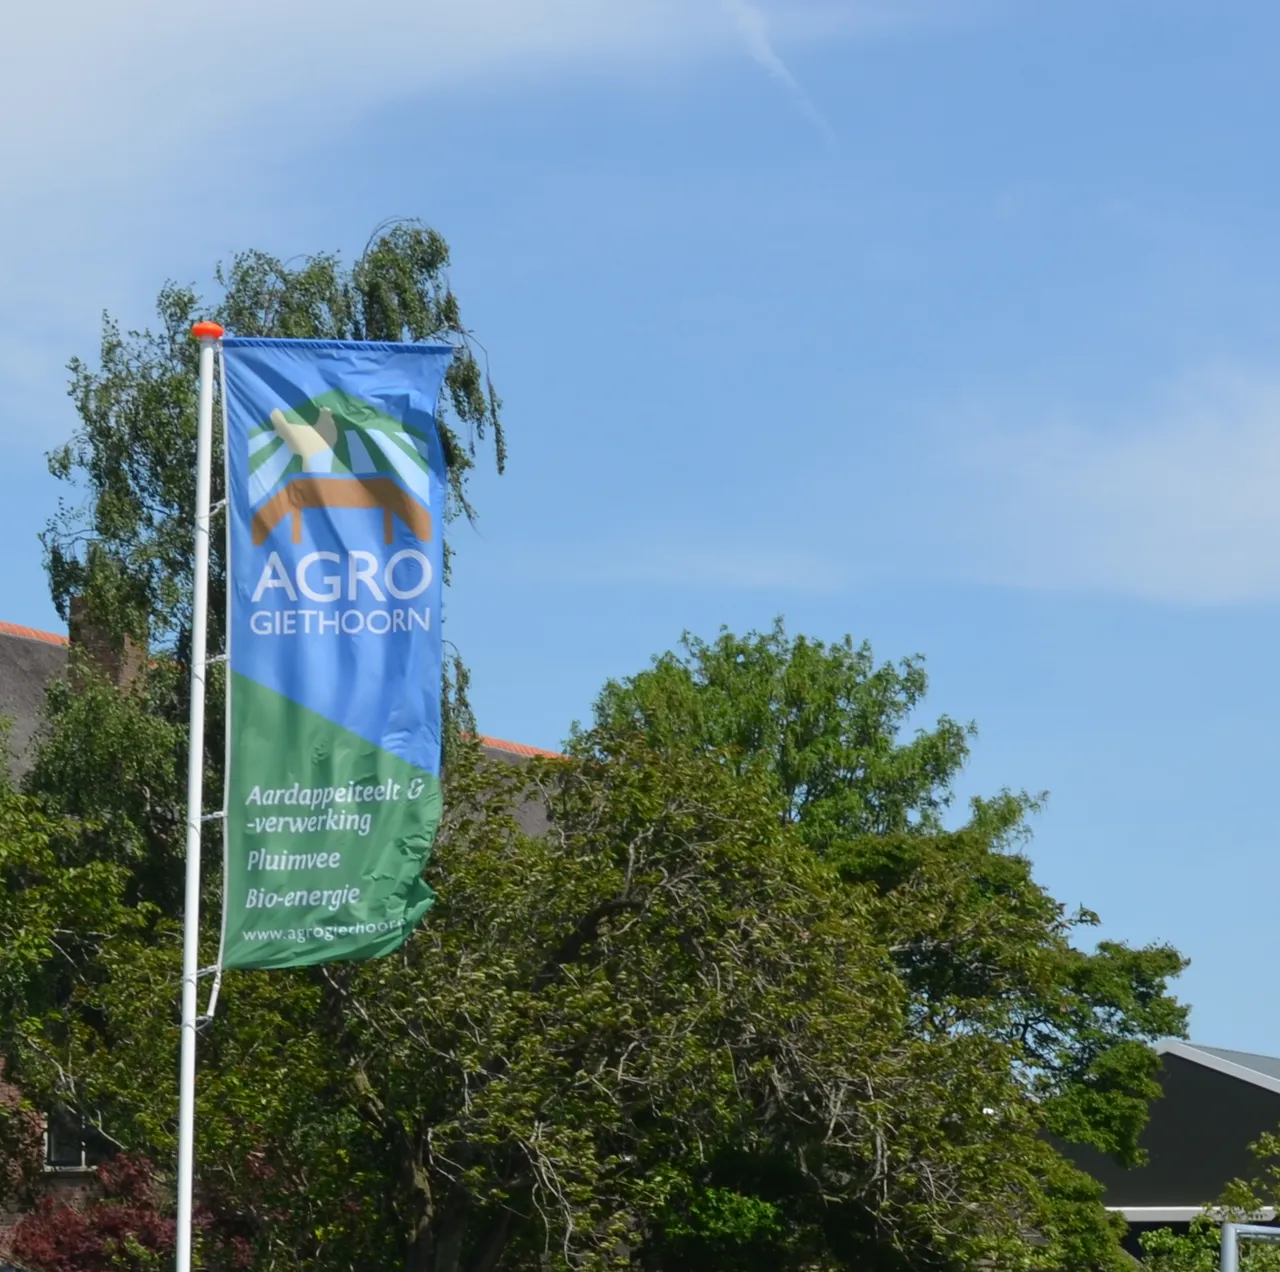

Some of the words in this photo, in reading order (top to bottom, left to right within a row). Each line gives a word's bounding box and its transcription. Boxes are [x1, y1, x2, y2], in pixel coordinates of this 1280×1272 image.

[251, 549, 433, 603] AGRO
[250, 607, 431, 636] GIETHOORN
[407, 777, 425, 800] &
[246, 808, 372, 836] -verwerking
[247, 848, 341, 871] Pluimvee
[245, 884, 361, 911] Bio-energie
